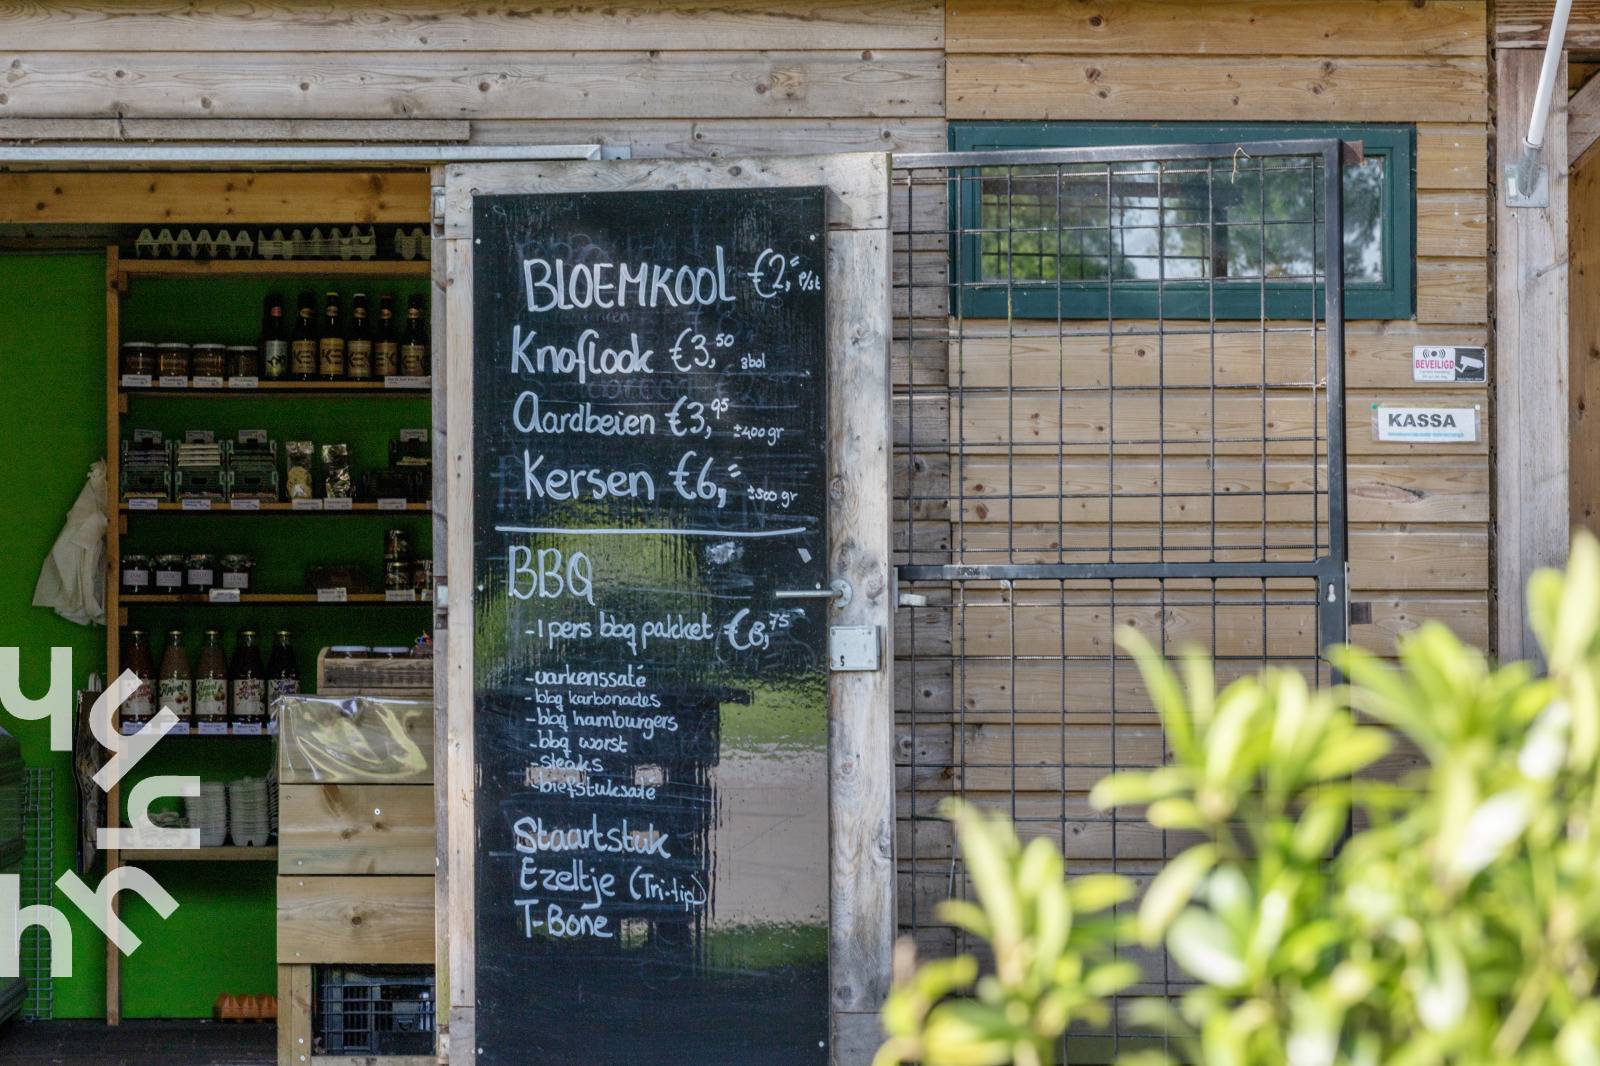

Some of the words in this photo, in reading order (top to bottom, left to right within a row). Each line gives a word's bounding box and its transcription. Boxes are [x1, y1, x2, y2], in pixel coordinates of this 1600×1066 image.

[523, 245, 736, 312] BLOEMKOOL
[511, 325, 654, 384] Knoflook
[1415, 359, 1455, 370] BEVEILIGD
[512, 390, 655, 435] Aardbeien
[1388, 413, 1457, 428] KASSA
[524, 449, 655, 501] Kersen
[508, 544, 595, 606] BBQ
[549, 621, 592, 649] pers
[599, 611, 637, 656] bbq
[641, 612, 714, 649] pakket
[568, 689, 661, 708] karbonades
[573, 710, 678, 740] hamburgers
[579, 735, 629, 753] worst
[513, 813, 671, 859] Staartstuk
[520, 857, 615, 909] Ezeltje
[514, 899, 613, 939] T-Bone
